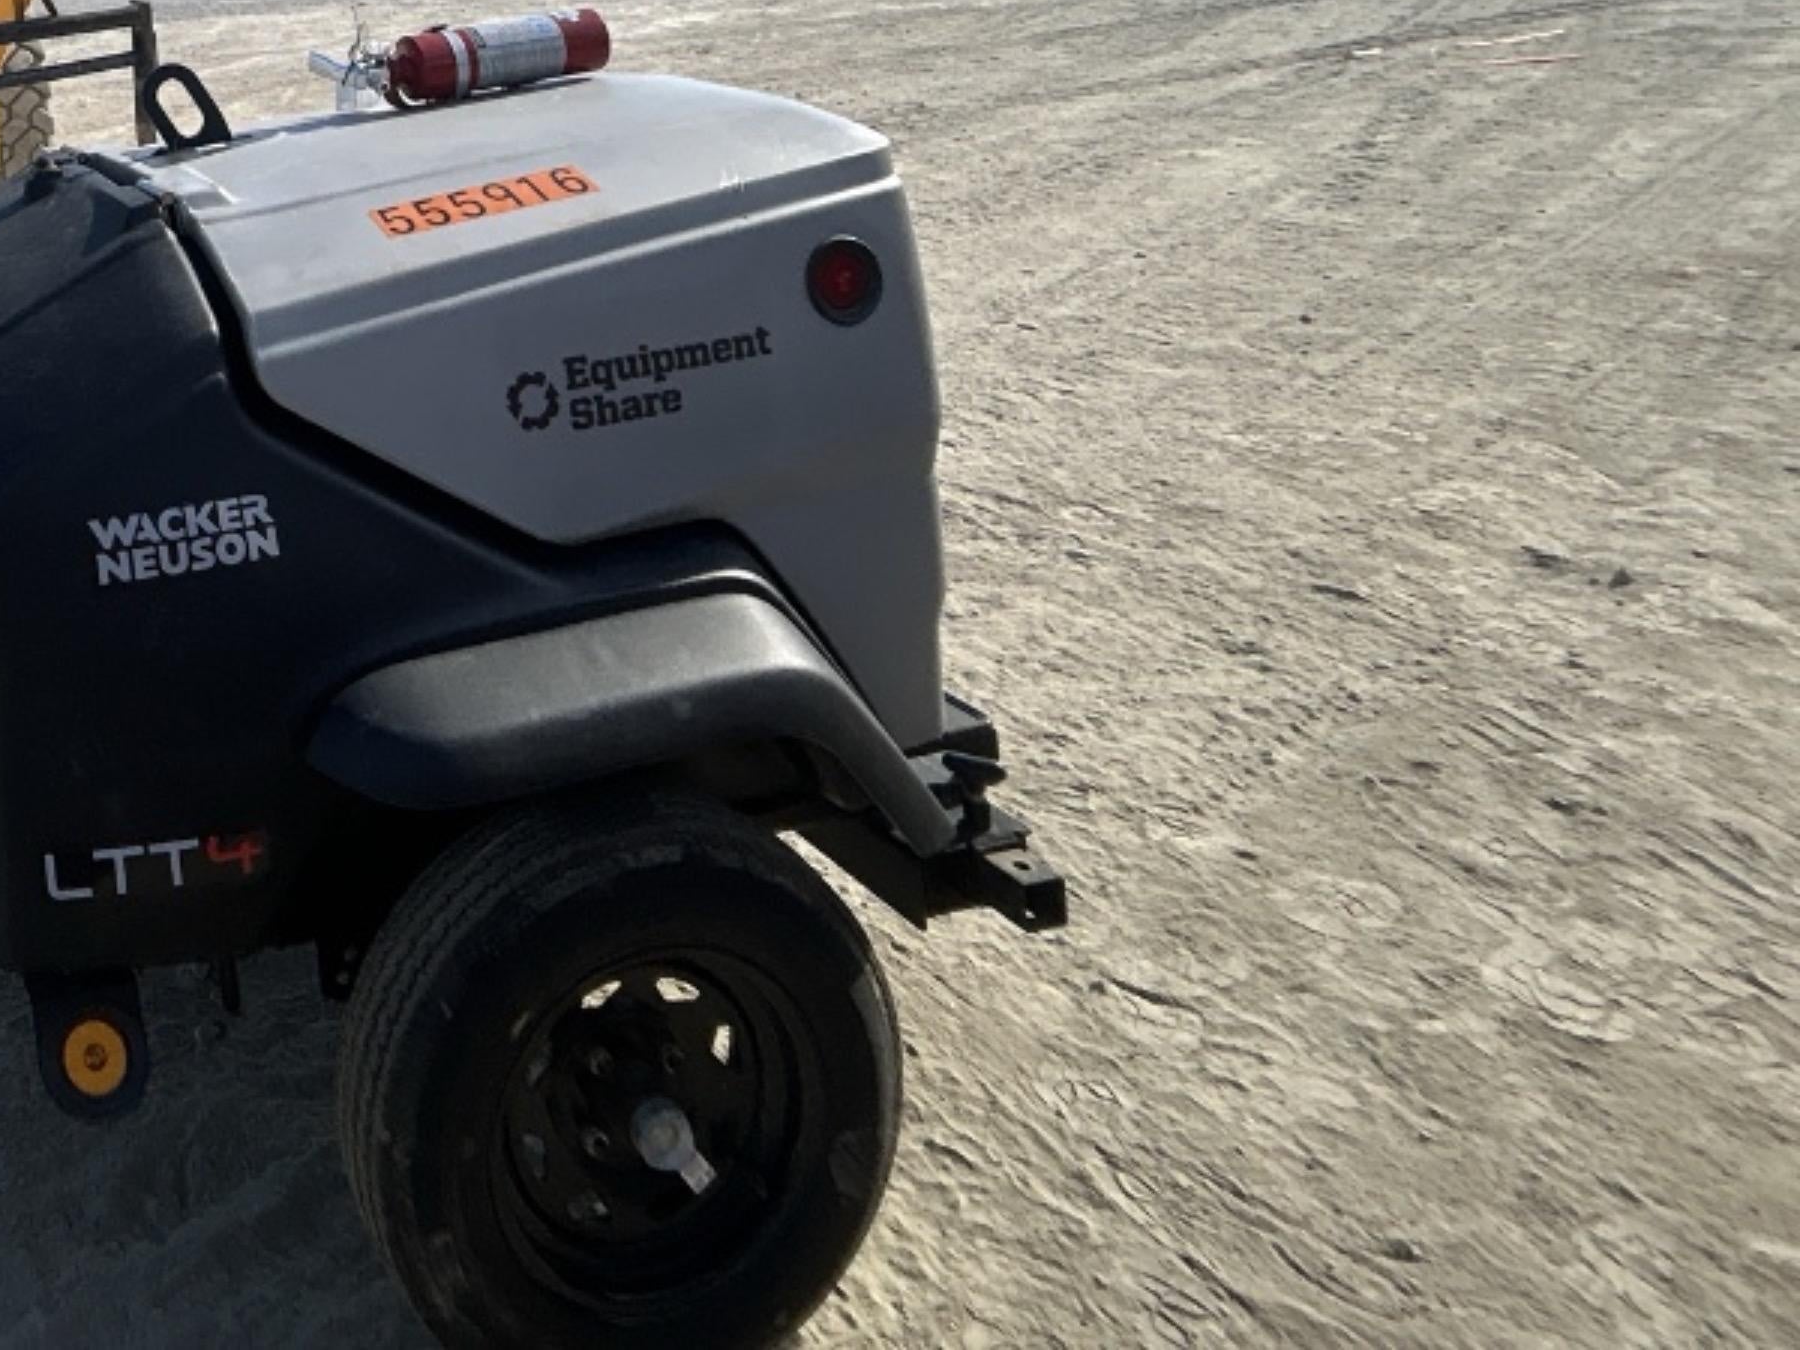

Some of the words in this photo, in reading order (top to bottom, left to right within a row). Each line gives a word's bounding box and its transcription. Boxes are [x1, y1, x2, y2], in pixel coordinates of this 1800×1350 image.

[378, 167, 589, 234] 555916
[563, 326, 772, 391] Equipment
[569, 389, 682, 430] Share
[87, 494, 274, 550] WACKER
[95, 526, 280, 586] NEUSON
